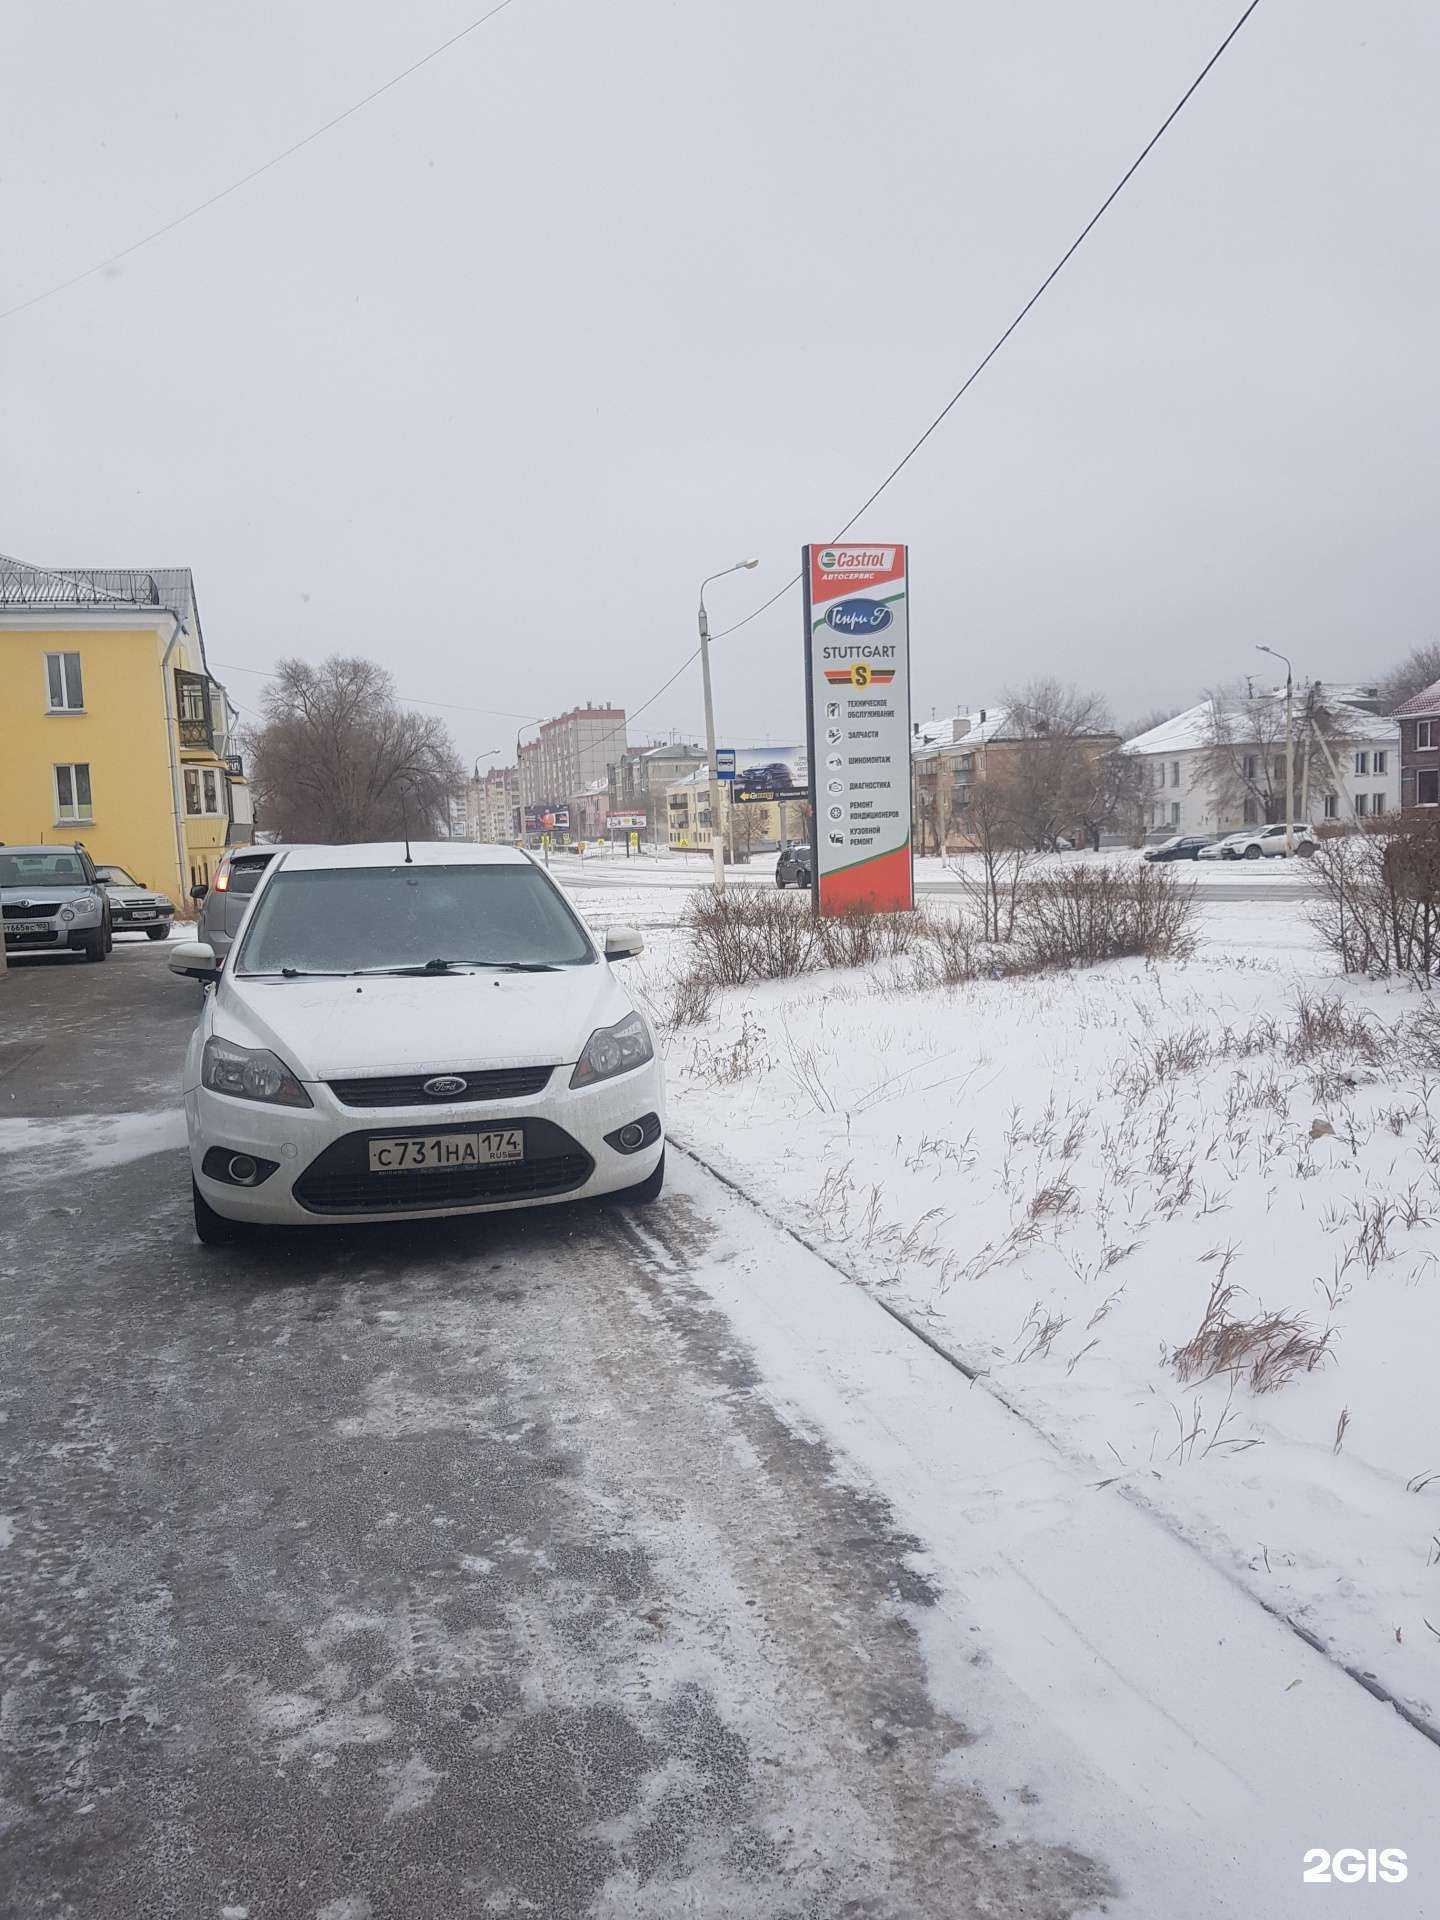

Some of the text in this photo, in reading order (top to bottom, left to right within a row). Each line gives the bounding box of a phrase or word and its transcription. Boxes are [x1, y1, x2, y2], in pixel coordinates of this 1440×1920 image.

[837, 552, 885, 567] Castrol
[822, 573, 875, 581] АВТОСЕРВИС
[822, 645, 896, 660] STUTTGART
[855, 666, 868, 686] S
[847, 699, 888, 708] ТЕХНИЧЕСКОЕ
[847, 710, 895, 719] ОБСЛУЖИВАНИЕ
[848, 731, 879, 739] ЗАПЧАСТИ
[848, 756, 891, 765] ШИНОМОНТАЖ
[849, 781, 891, 790] ДИАГНОСТИКА
[849, 801, 873, 809] РЕМОНТ
[849, 811, 899, 820] КОНДИЦИОНЕРОВ
[849, 825, 881, 835] КУЗОВНОЙ
[849, 838, 873, 846] РЕМОНТ
[434, 1081, 457, 1092] Ford
[378, 1132, 517, 1167] С731НА 174
[489, 1151, 509, 1160] RUS
